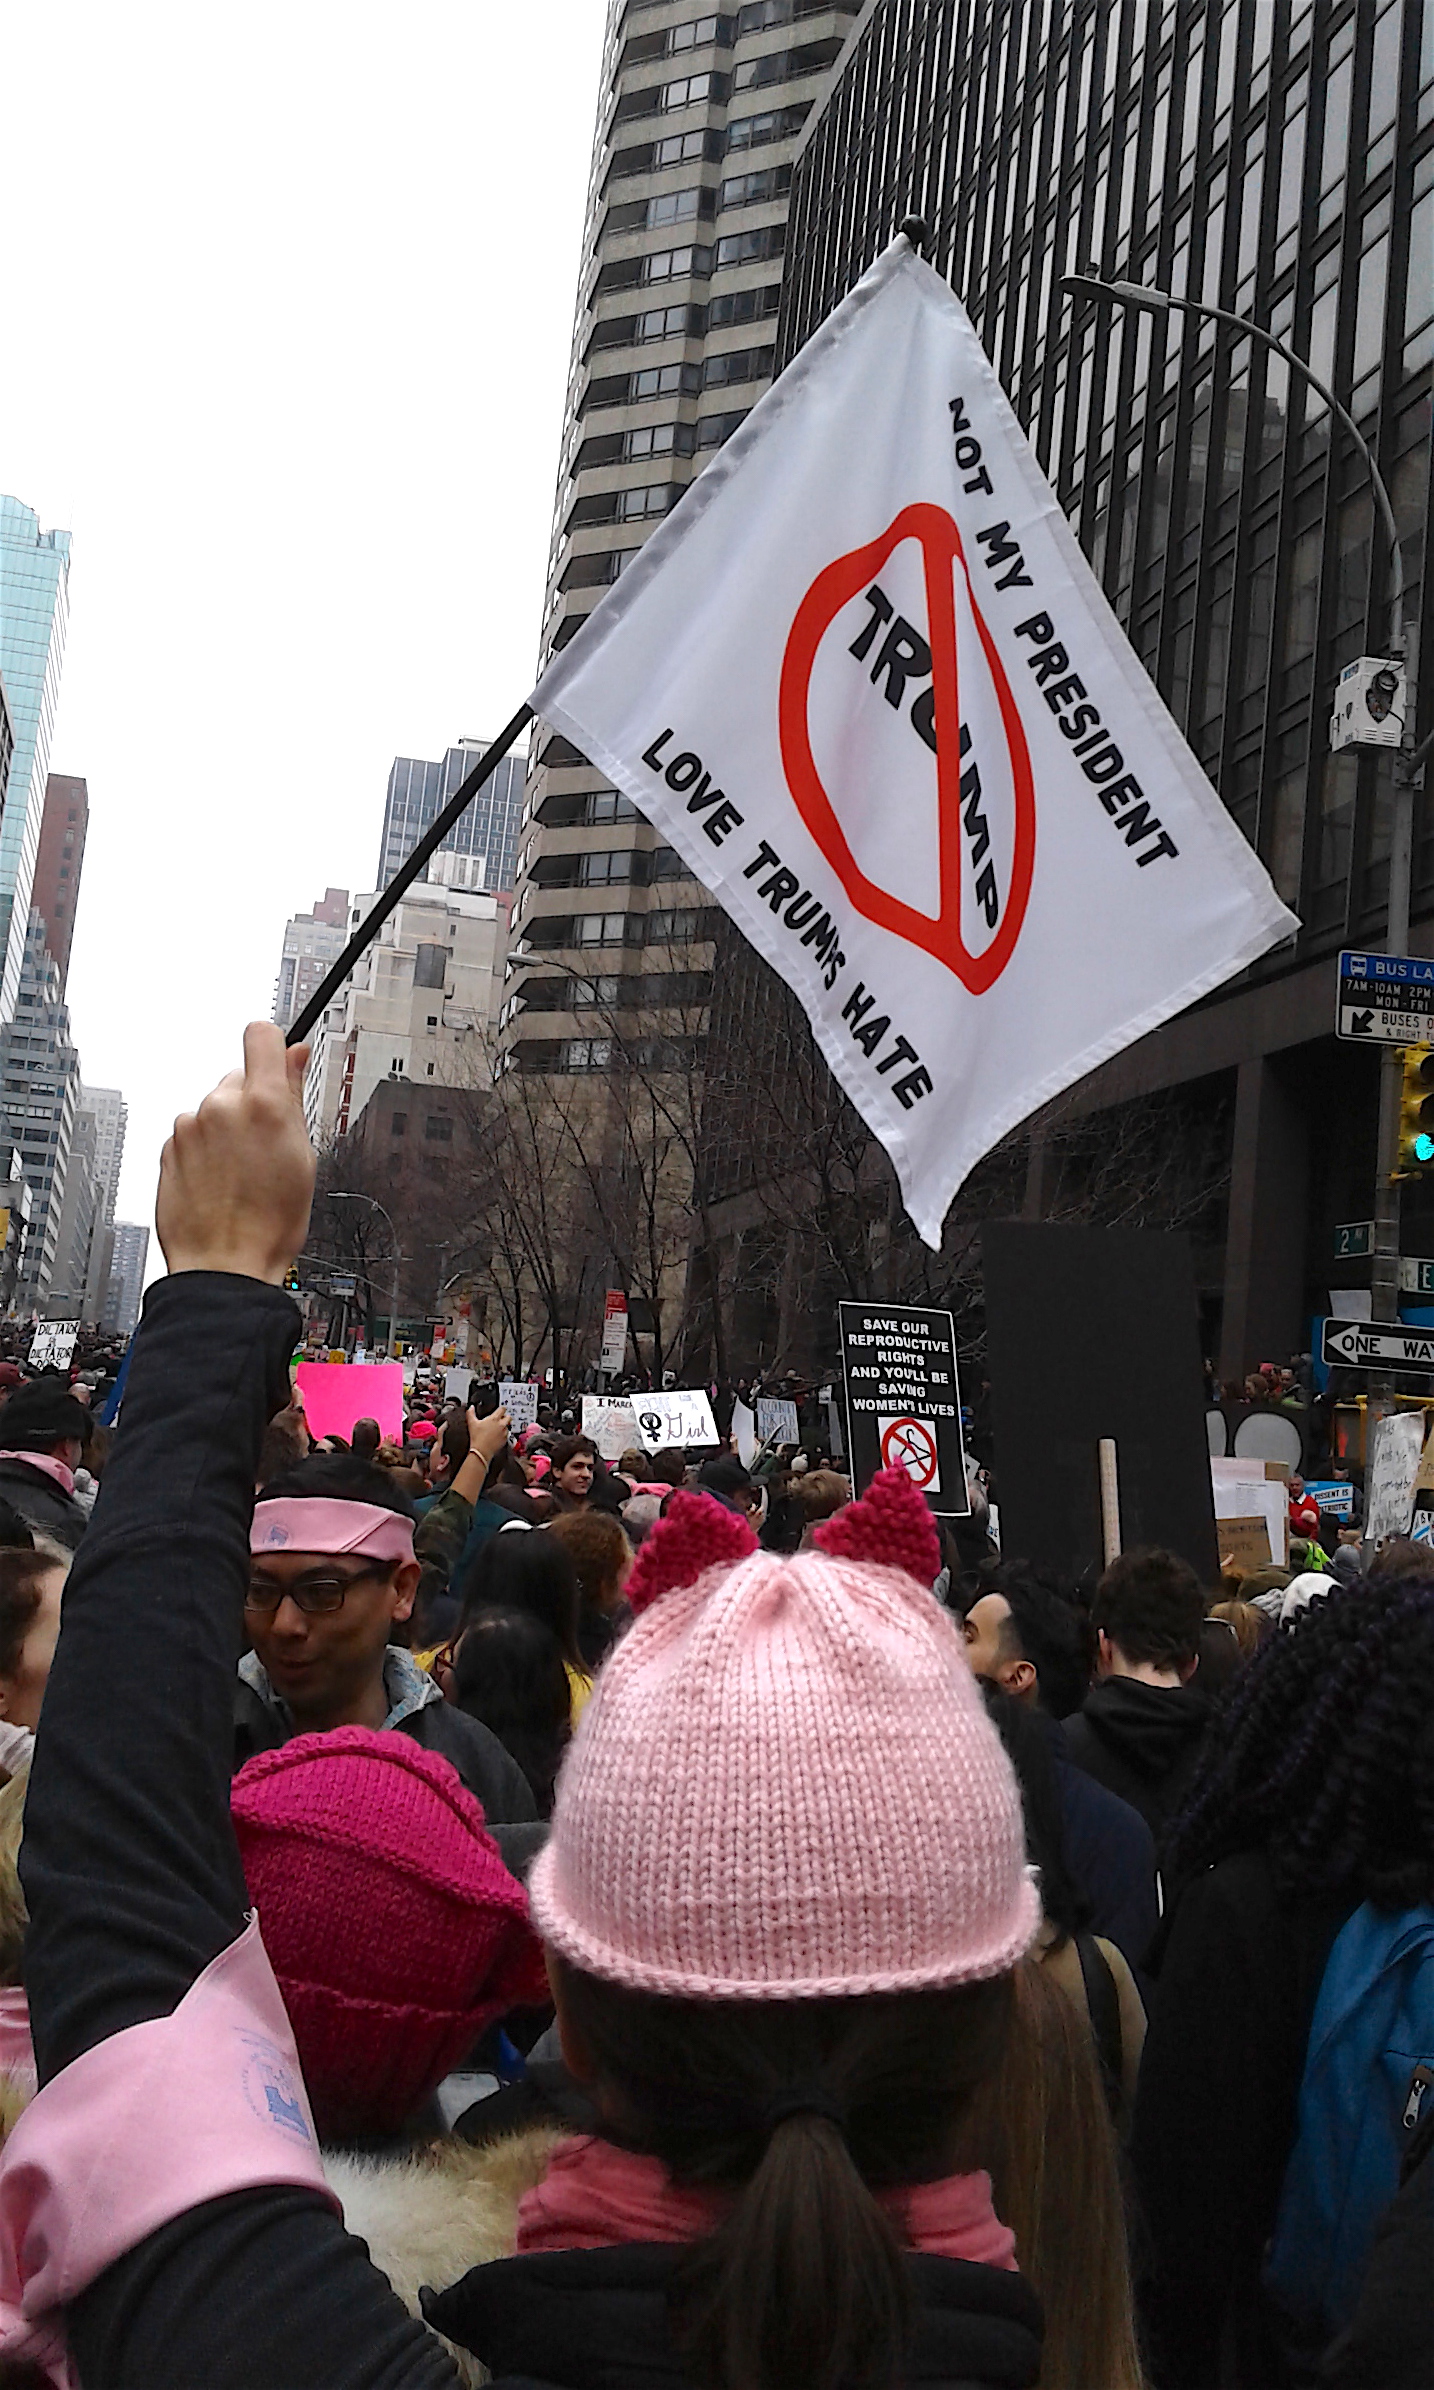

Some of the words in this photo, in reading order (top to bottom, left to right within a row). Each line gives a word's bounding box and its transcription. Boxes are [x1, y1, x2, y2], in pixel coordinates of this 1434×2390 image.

[949, 397, 993, 496] NOT
[976, 521, 1033, 592] MY
[1014, 611, 1179, 867] PRESIDENT
[849, 584, 999, 928] TRUMP
[642, 728, 744, 846] LOVE
[842, 982, 934, 1110] HATE
[1376, 962, 1407, 977] BUS
[1413, 965, 1434, 980] LA
[1376, 996, 1399, 1008] MON
[1411, 1000, 1428, 1011] FRI
[1382, 1012, 1419, 1027] BUSES
[1396, 1029, 1420, 1039] RIGHT
[1341, 1229, 1349, 1252] 2
[1422, 1264, 1432, 1288] E
[863, 1319, 898, 1332] SAVE
[901, 1322, 929, 1335] OUR
[848, 1333, 950, 1353] REPRODUCTIVE
[1342, 1334, 1381, 1354] ONE
[877, 1351, 925, 1366] RIGHTS
[851, 1366, 880, 1378] AND
[931, 1372, 949, 1384] BE
[878, 1383, 926, 1398] SAVING
[918, 1402, 955, 1417] LIVES
[1341, 1488, 1349, 1496] IS
[1321, 1502, 1348, 1513] ATRIOTIC
